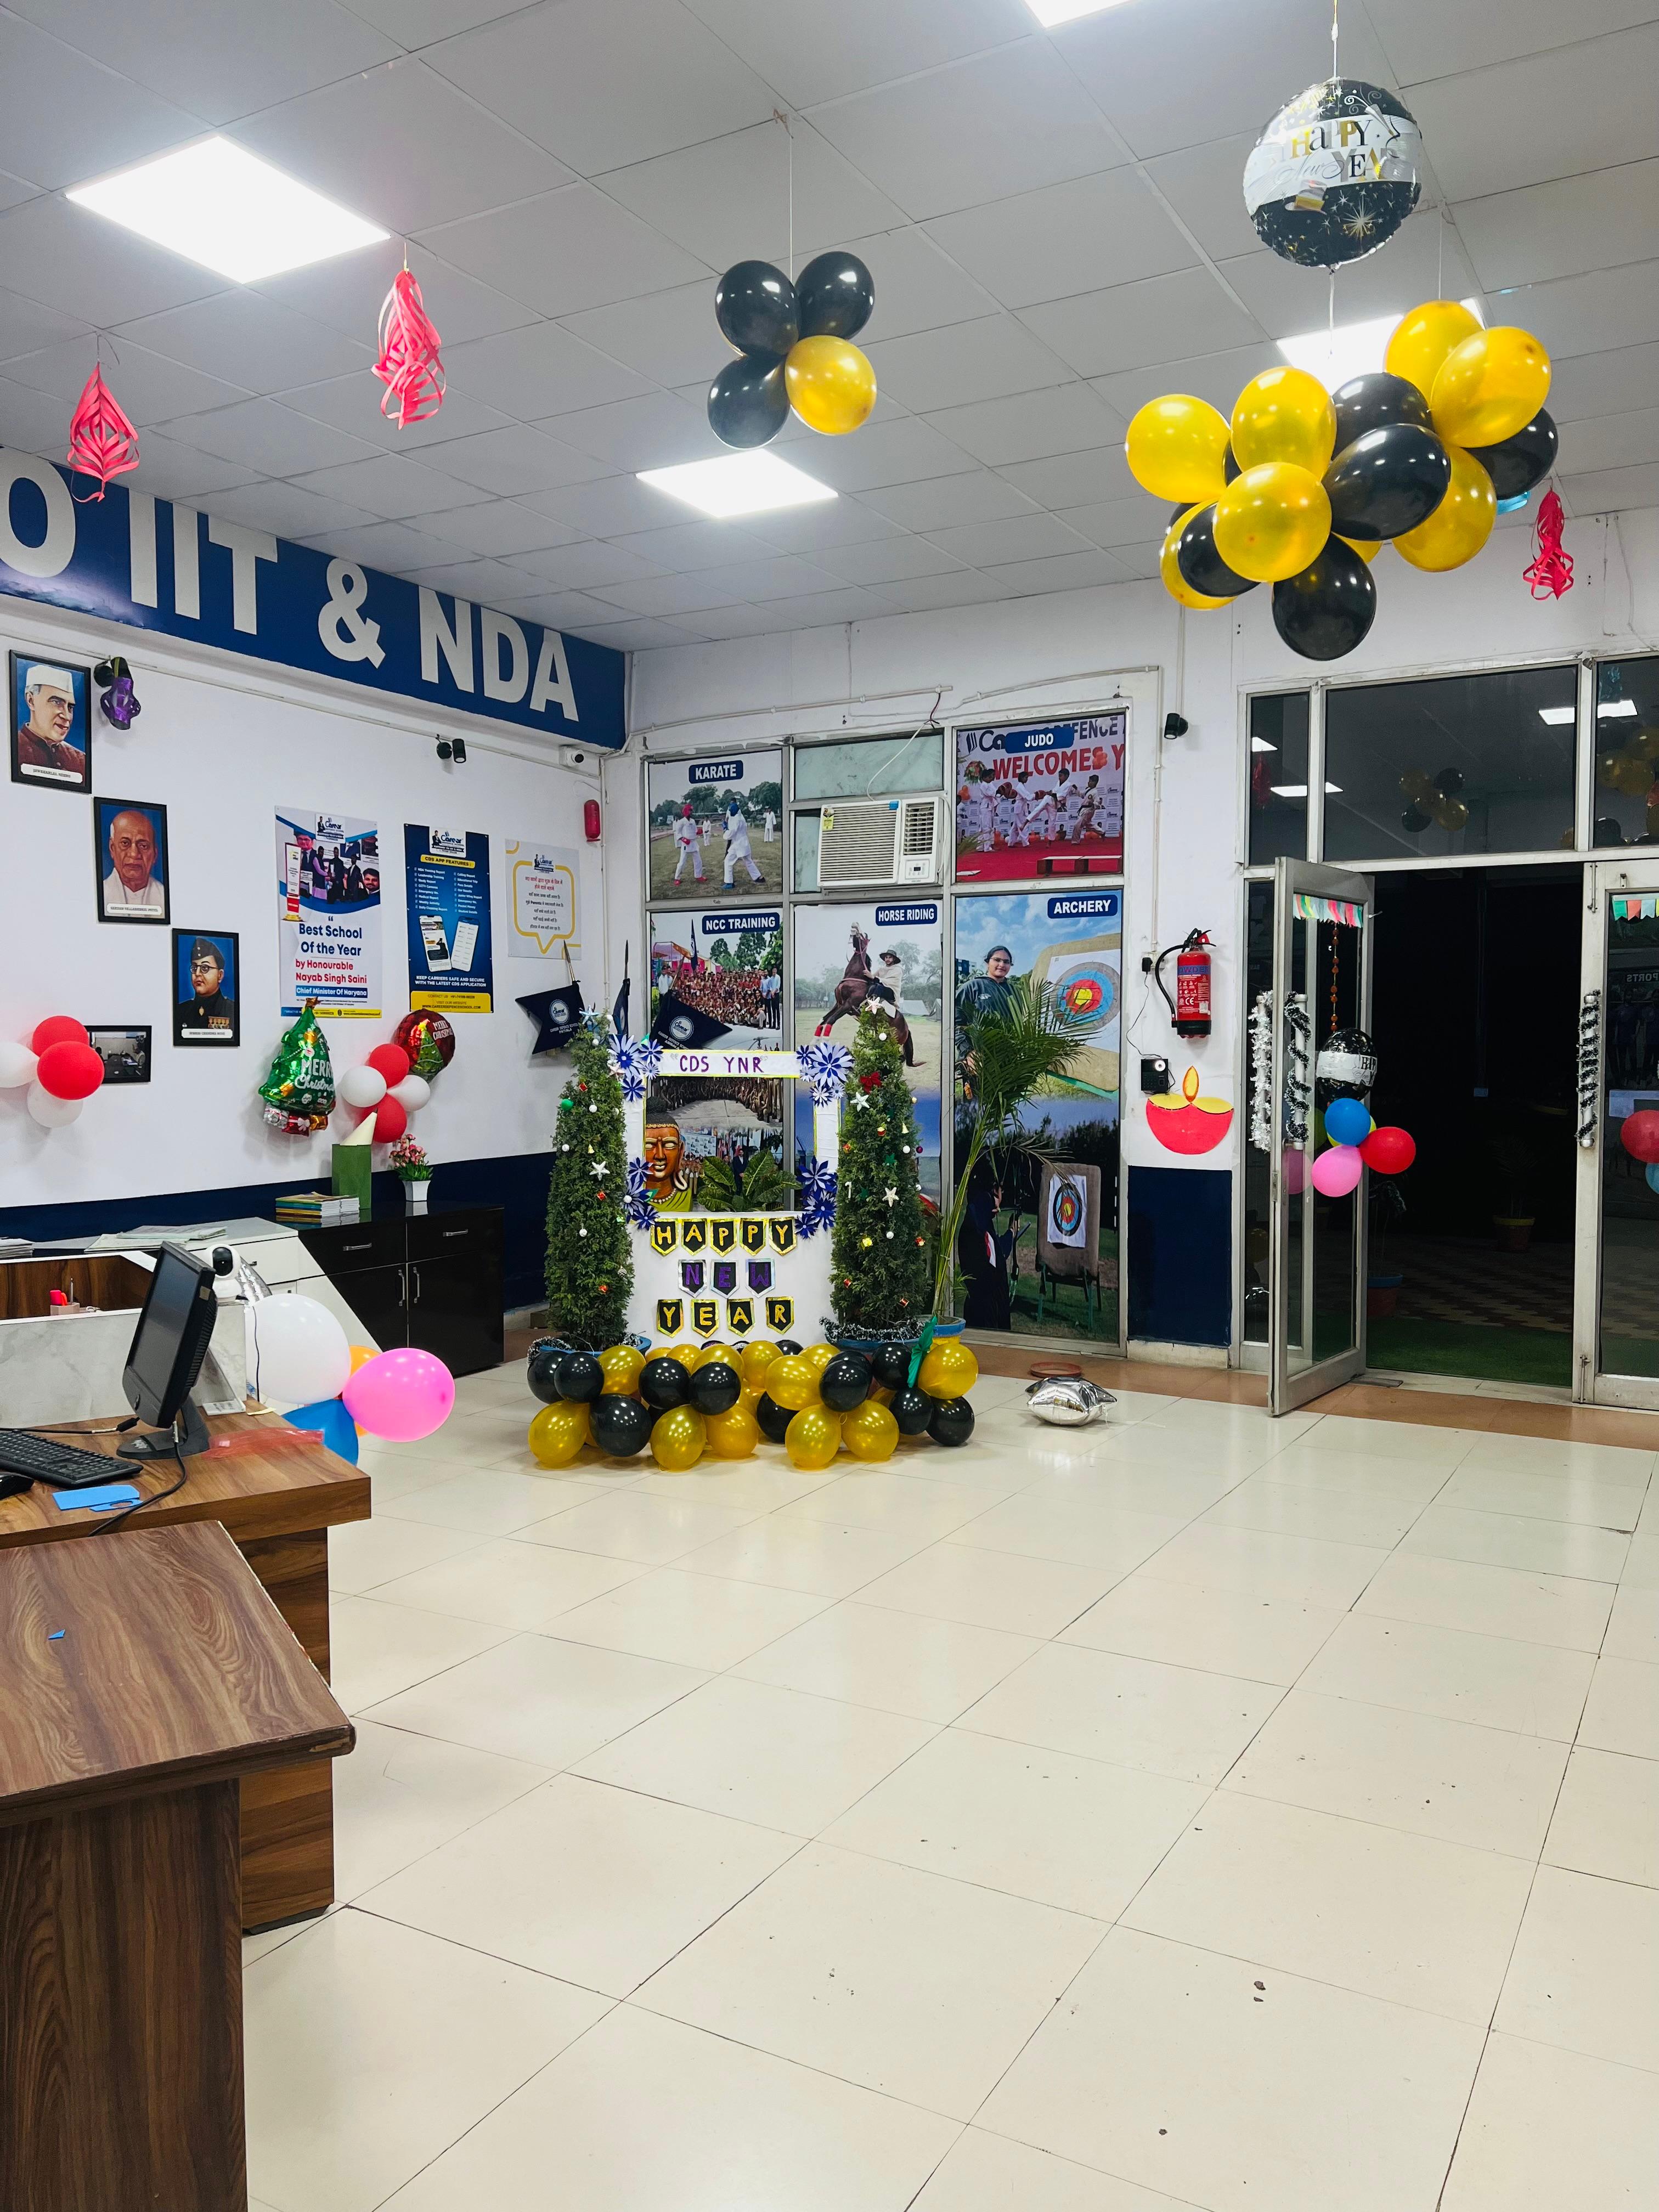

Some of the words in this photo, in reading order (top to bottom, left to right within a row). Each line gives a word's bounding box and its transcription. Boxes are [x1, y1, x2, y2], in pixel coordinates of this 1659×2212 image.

[129, 488, 278, 635] IIT
[318, 558, 386, 669] &
[419, 585, 579, 722] NDA
[1025, 733, 1053, 747] JUDO
[696, 764, 736, 780] KARATE
[1054, 900, 1111, 913] ARCHERY
[879, 910, 905, 922] HORSE
[907, 908, 934, 921] RIDING
[299, 923, 323, 936] Best
[325, 925, 362, 939] School
[706, 919, 725, 930] NCC
[729, 917, 775, 929] TRAINING
[301, 941, 314, 952] Of
[317, 943, 335, 955] the
[337, 944, 362, 956] Year
[296, 958, 306, 969] by
[307, 960, 353, 970] Honourable
[296, 972, 323, 983] Nayab
[324, 973, 346, 984] Singh
[348, 975, 367, 984] Saini
[301, 1058, 333, 1079] MERR
[657, 1224, 789, 1246] HAPPY
[686, 1263, 769, 1288] NEW
[663, 1304, 787, 1328] YEAR
